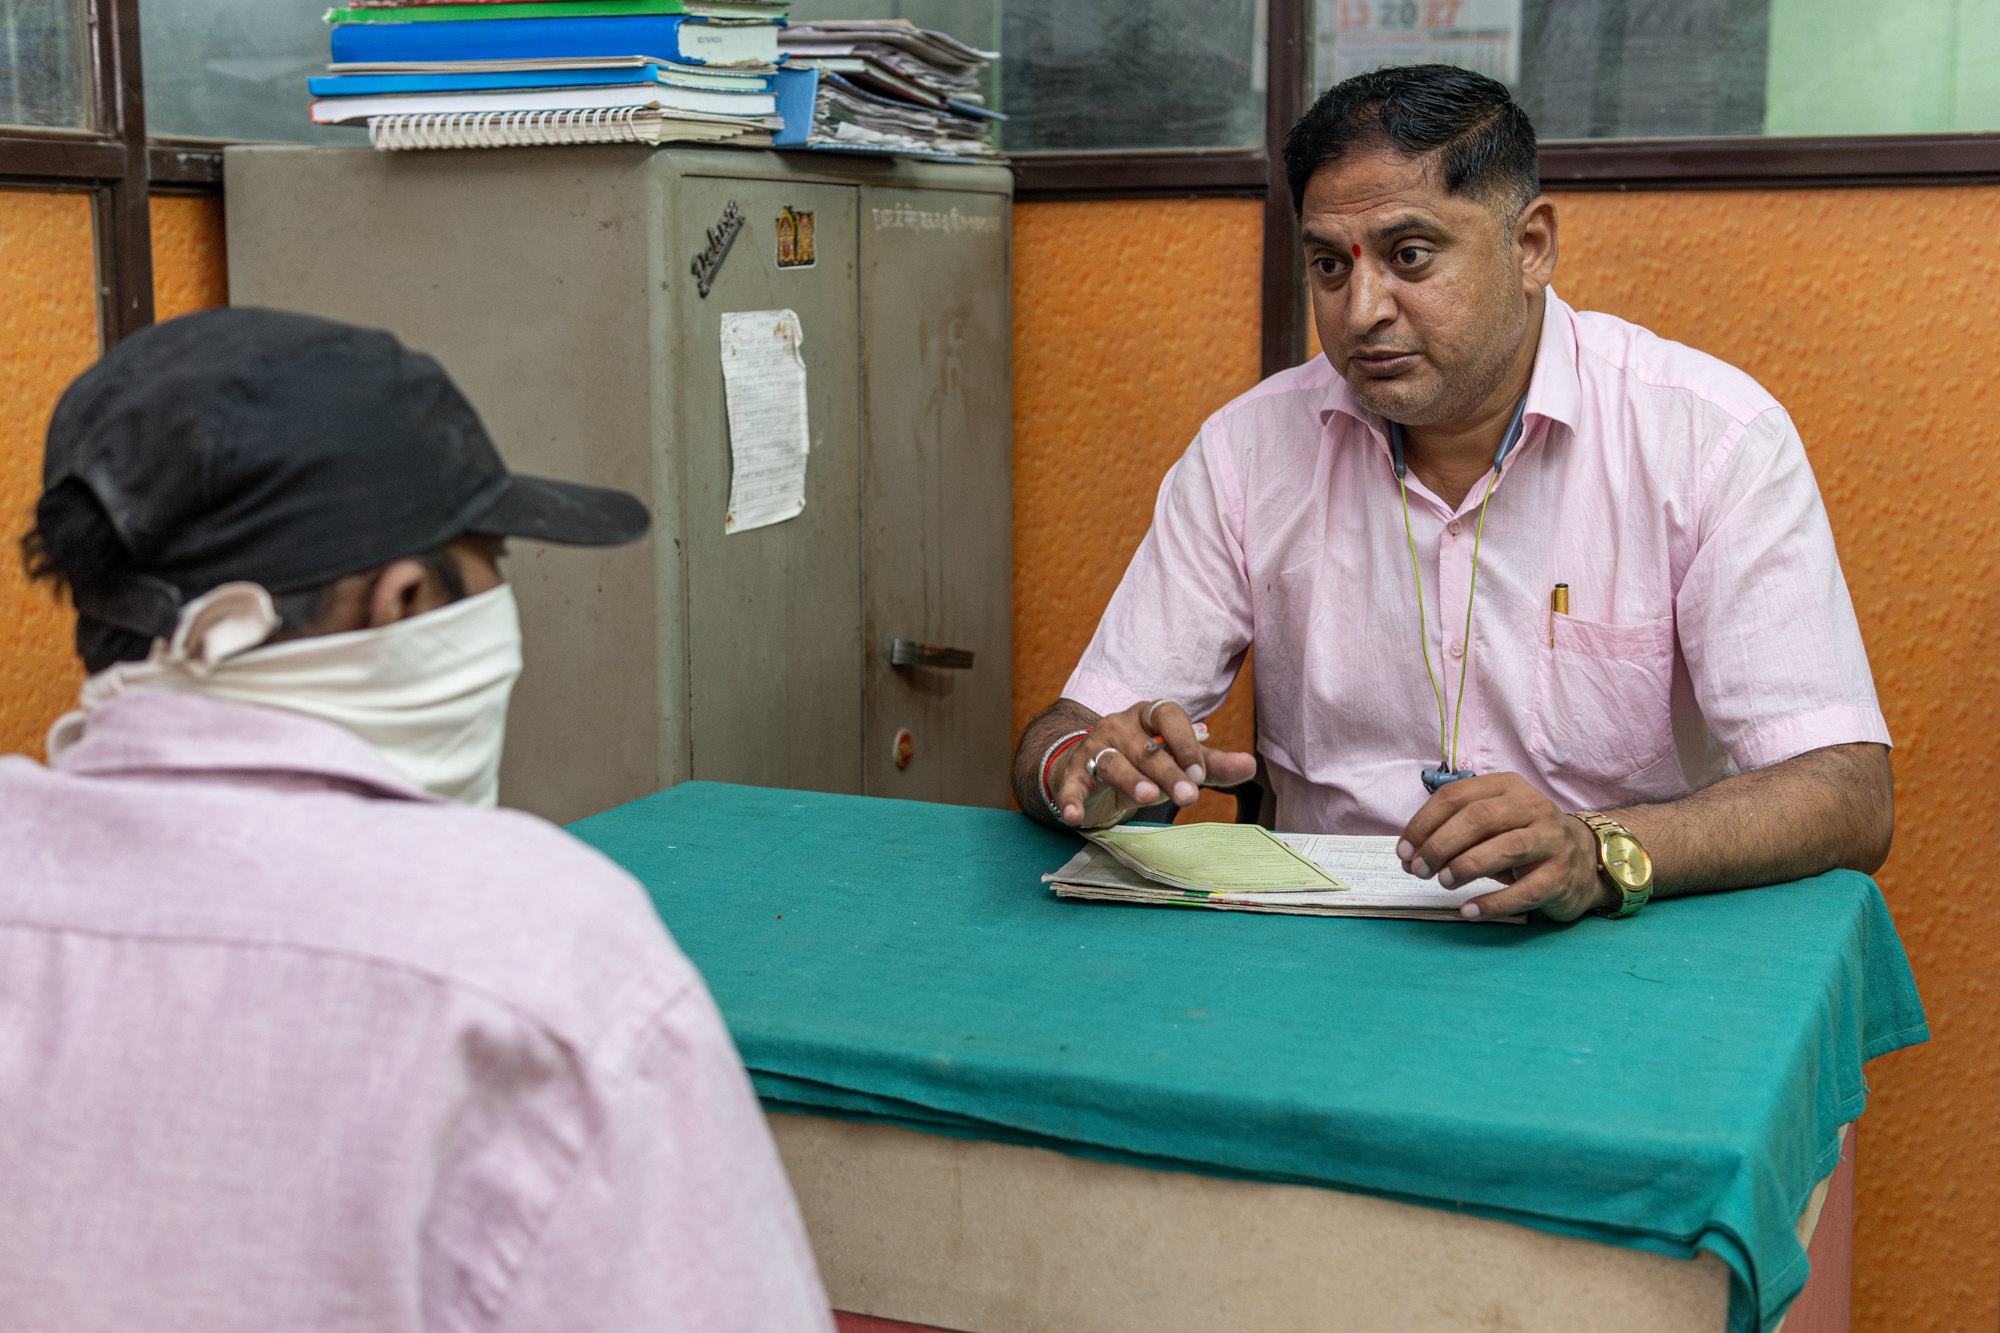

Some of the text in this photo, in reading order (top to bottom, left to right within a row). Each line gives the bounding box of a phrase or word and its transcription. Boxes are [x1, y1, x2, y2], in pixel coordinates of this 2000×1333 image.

[1377, 0, 1418, 28] 20
[1422, 0, 1460, 28] 27
[690, 199, 742, 297] Deluxe
